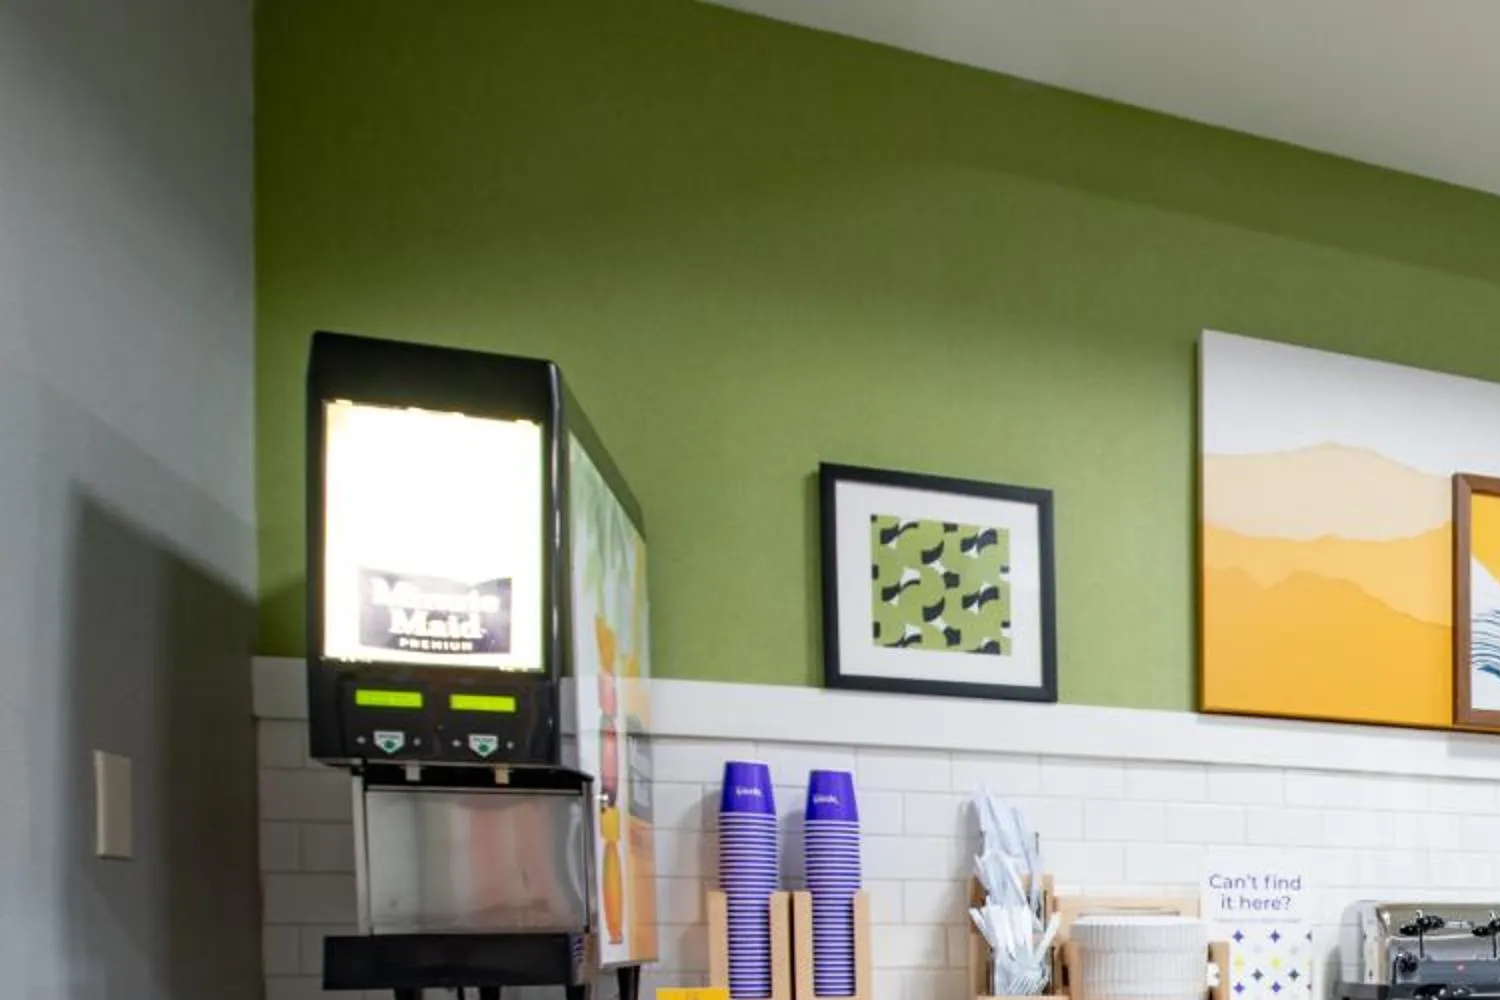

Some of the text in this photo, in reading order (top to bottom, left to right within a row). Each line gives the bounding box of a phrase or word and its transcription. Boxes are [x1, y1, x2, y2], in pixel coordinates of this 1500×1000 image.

[389, 608, 483, 638] Maid
[399, 637, 473, 651] PREMIUM
[1208, 873, 1302, 891] Can't find
[1221, 893, 1292, 910] it here?
